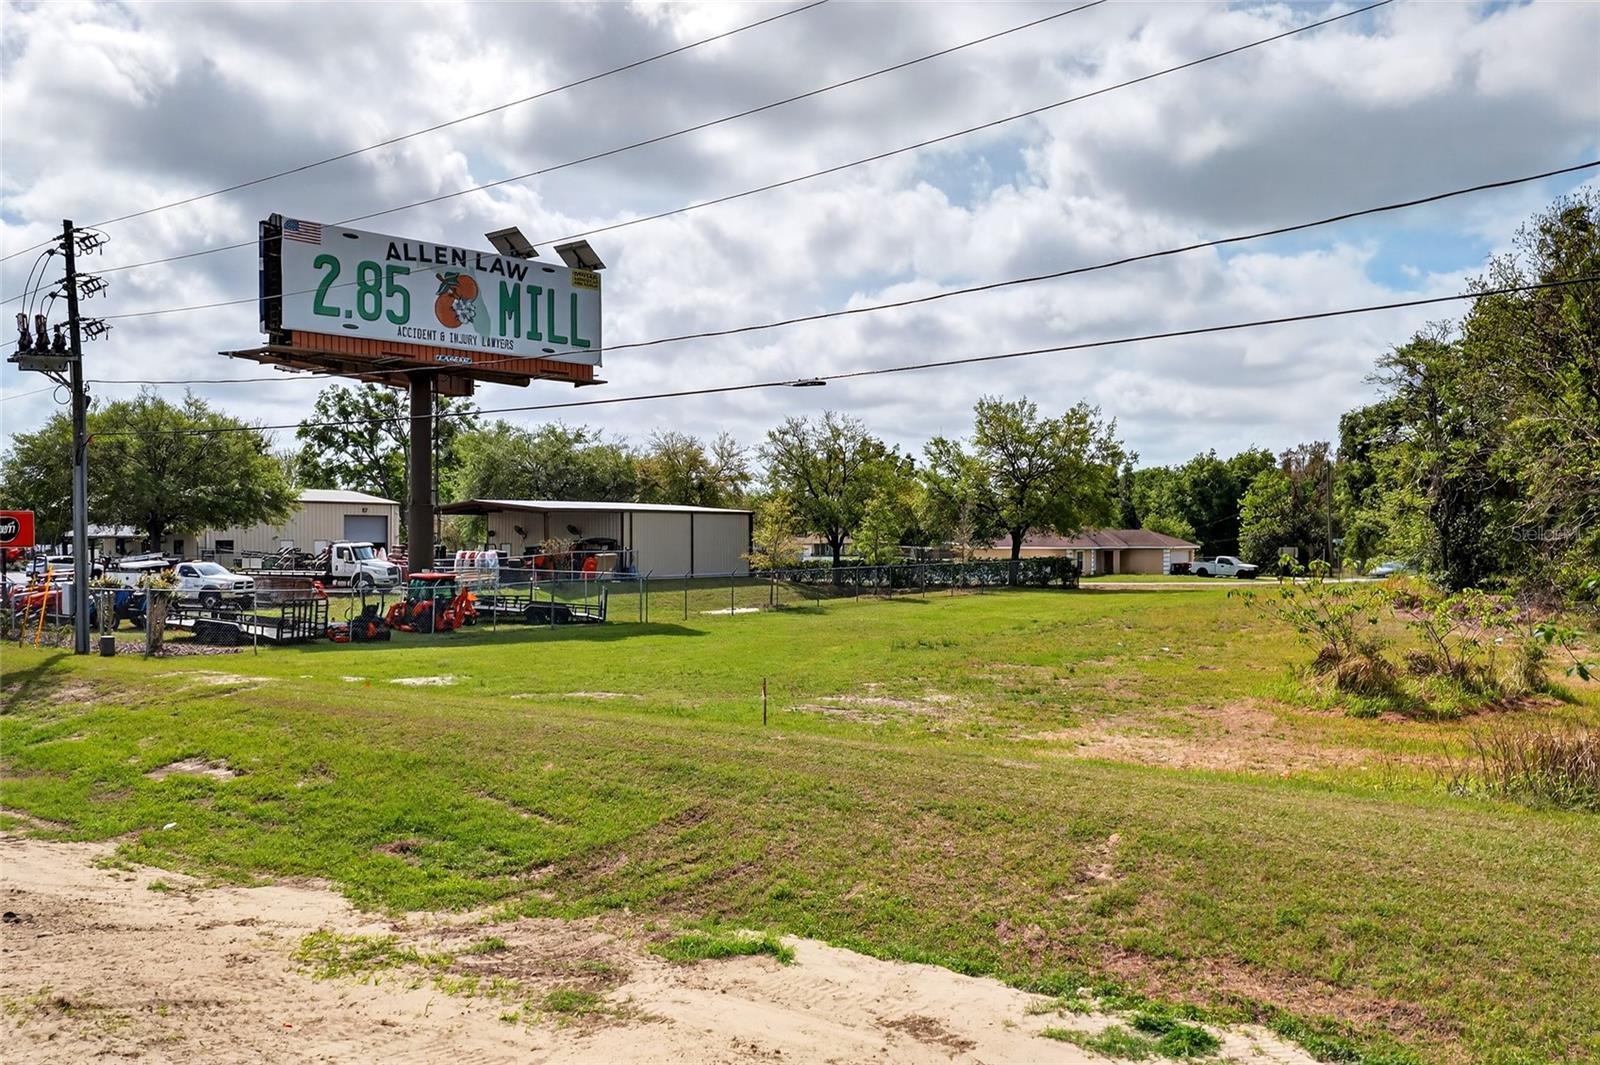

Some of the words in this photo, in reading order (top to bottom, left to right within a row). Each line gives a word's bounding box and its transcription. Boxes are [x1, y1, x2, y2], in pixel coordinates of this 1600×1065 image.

[386, 242, 467, 267] ALLEN
[476, 253, 528, 282] LAW
[313, 254, 410, 325] 2.85
[499, 281, 590, 348] MILL
[397, 326, 437, 341] ACCIDENT
[440, 331, 445, 342] &
[450, 332, 477, 346] INJURY
[482, 336, 514, 350] LAWYERS
